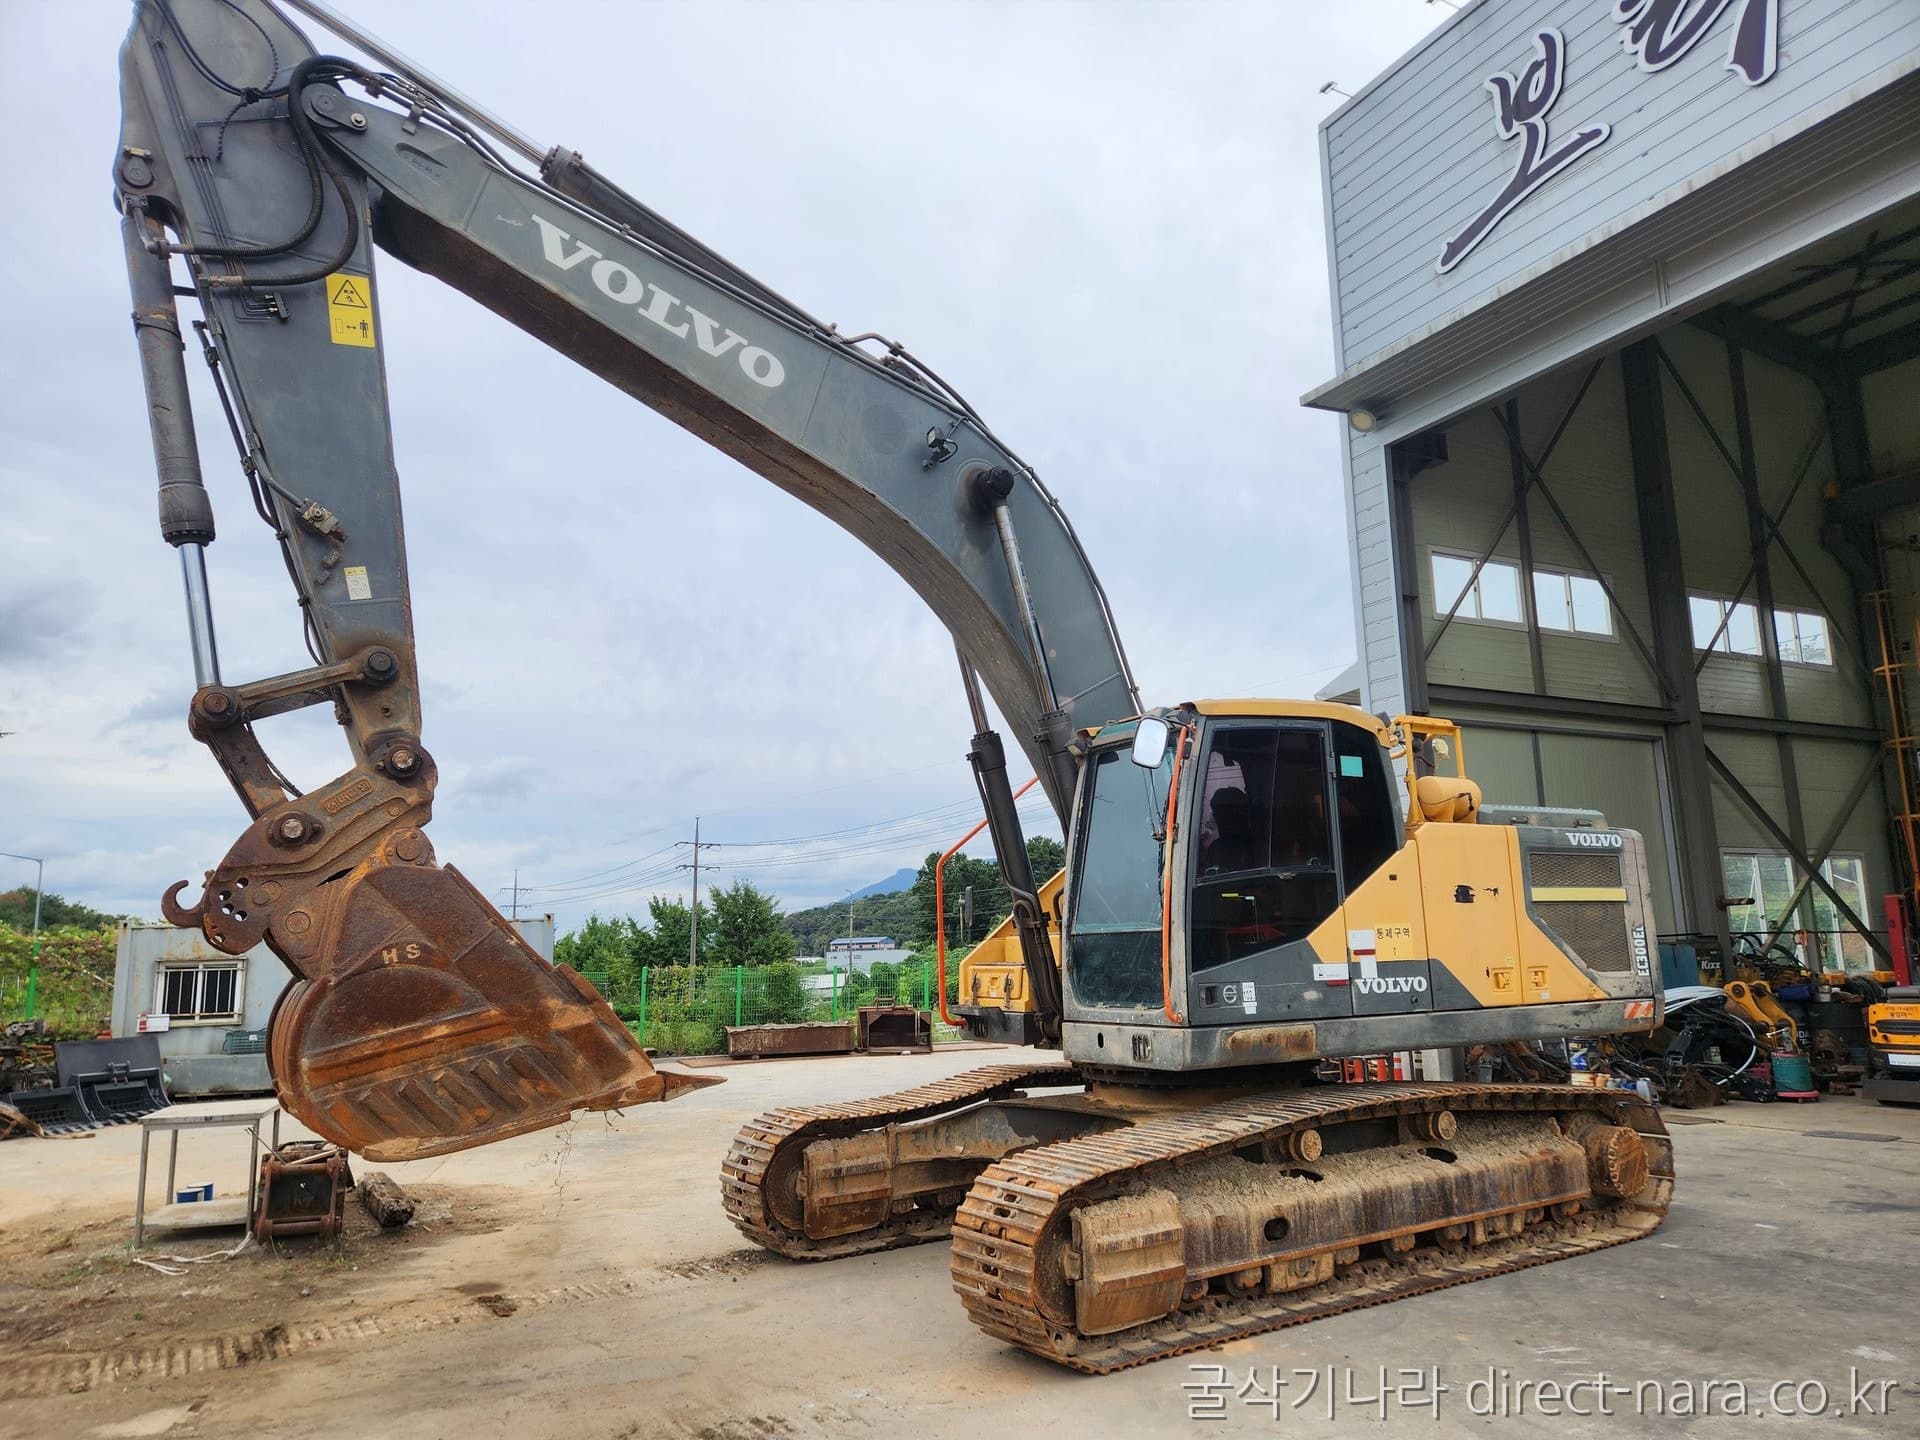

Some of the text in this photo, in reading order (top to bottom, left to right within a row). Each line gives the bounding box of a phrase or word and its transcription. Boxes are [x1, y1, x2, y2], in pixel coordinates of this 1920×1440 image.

[531, 214, 785, 388] VOLVO
[1566, 832, 1623, 848] VOLVO
[1376, 927, 1411, 940] 통제구역
[1355, 976, 1428, 995] VOLVO
